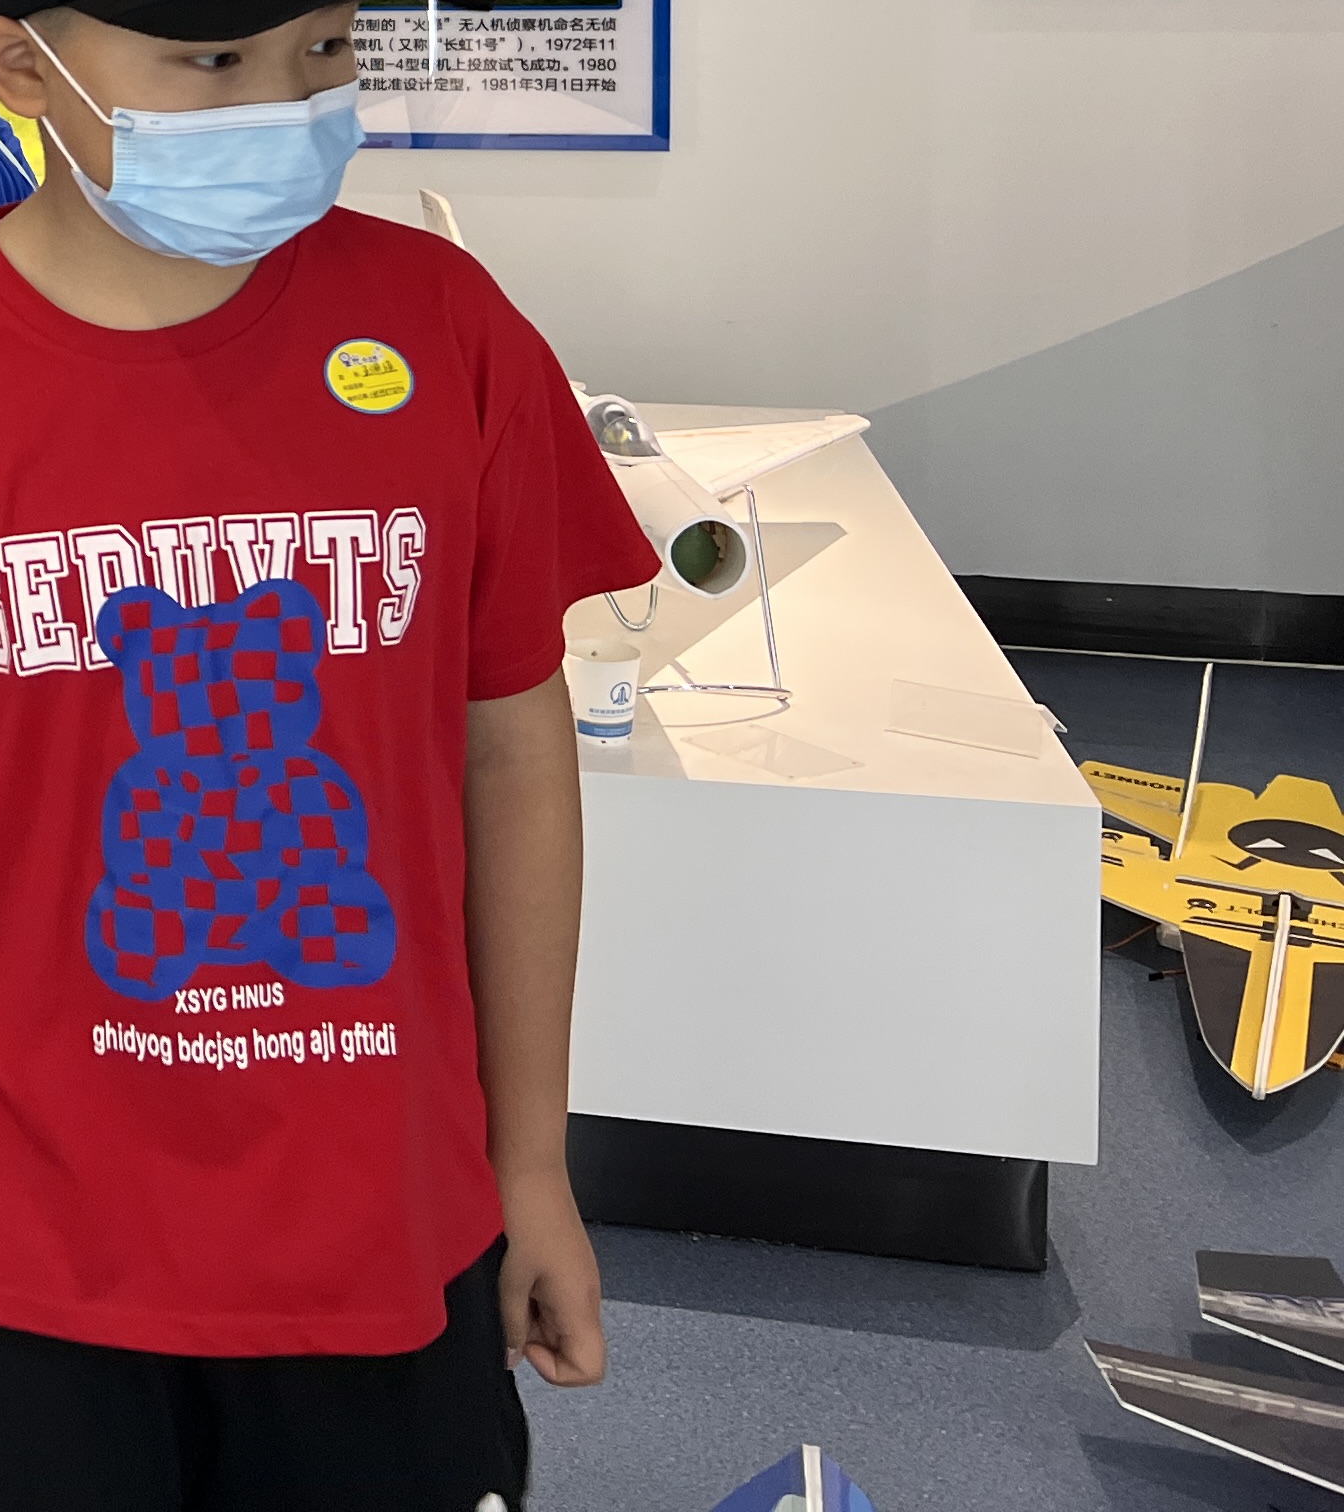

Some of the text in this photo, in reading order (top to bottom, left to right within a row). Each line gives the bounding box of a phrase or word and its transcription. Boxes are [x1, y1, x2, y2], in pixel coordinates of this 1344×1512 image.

[173, 981, 284, 1015] XSYG HNUS
[92, 1021, 172, 1066] ghidyog
[177, 1027, 248, 1070] bdcjsg
[253, 1027, 305, 1065] hong
[340, 1022, 397, 1064] gftidi
